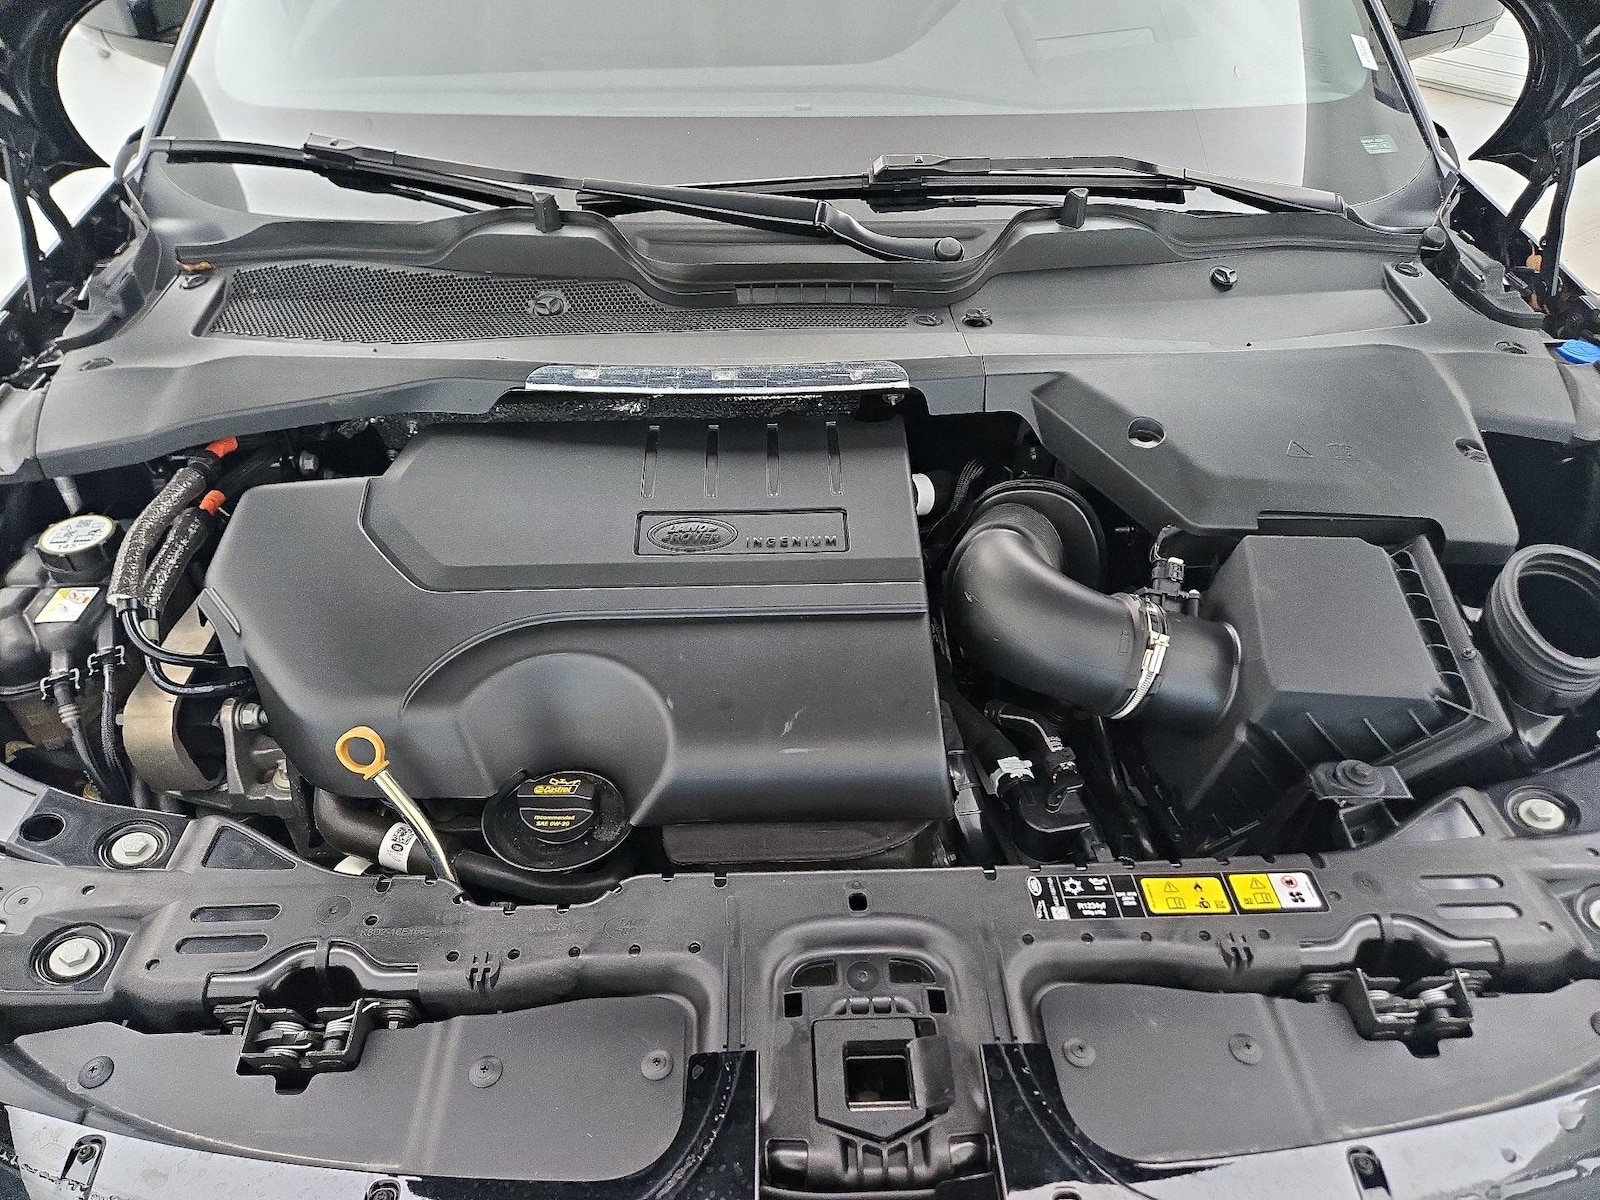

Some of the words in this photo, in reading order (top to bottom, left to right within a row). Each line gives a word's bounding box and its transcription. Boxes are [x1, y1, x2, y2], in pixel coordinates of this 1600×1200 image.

[667, 524, 718, 534] LAND
[668, 532, 721, 545] ROVER
[746, 535, 838, 548] INGENIUM
[543, 785, 572, 794] Castrol
